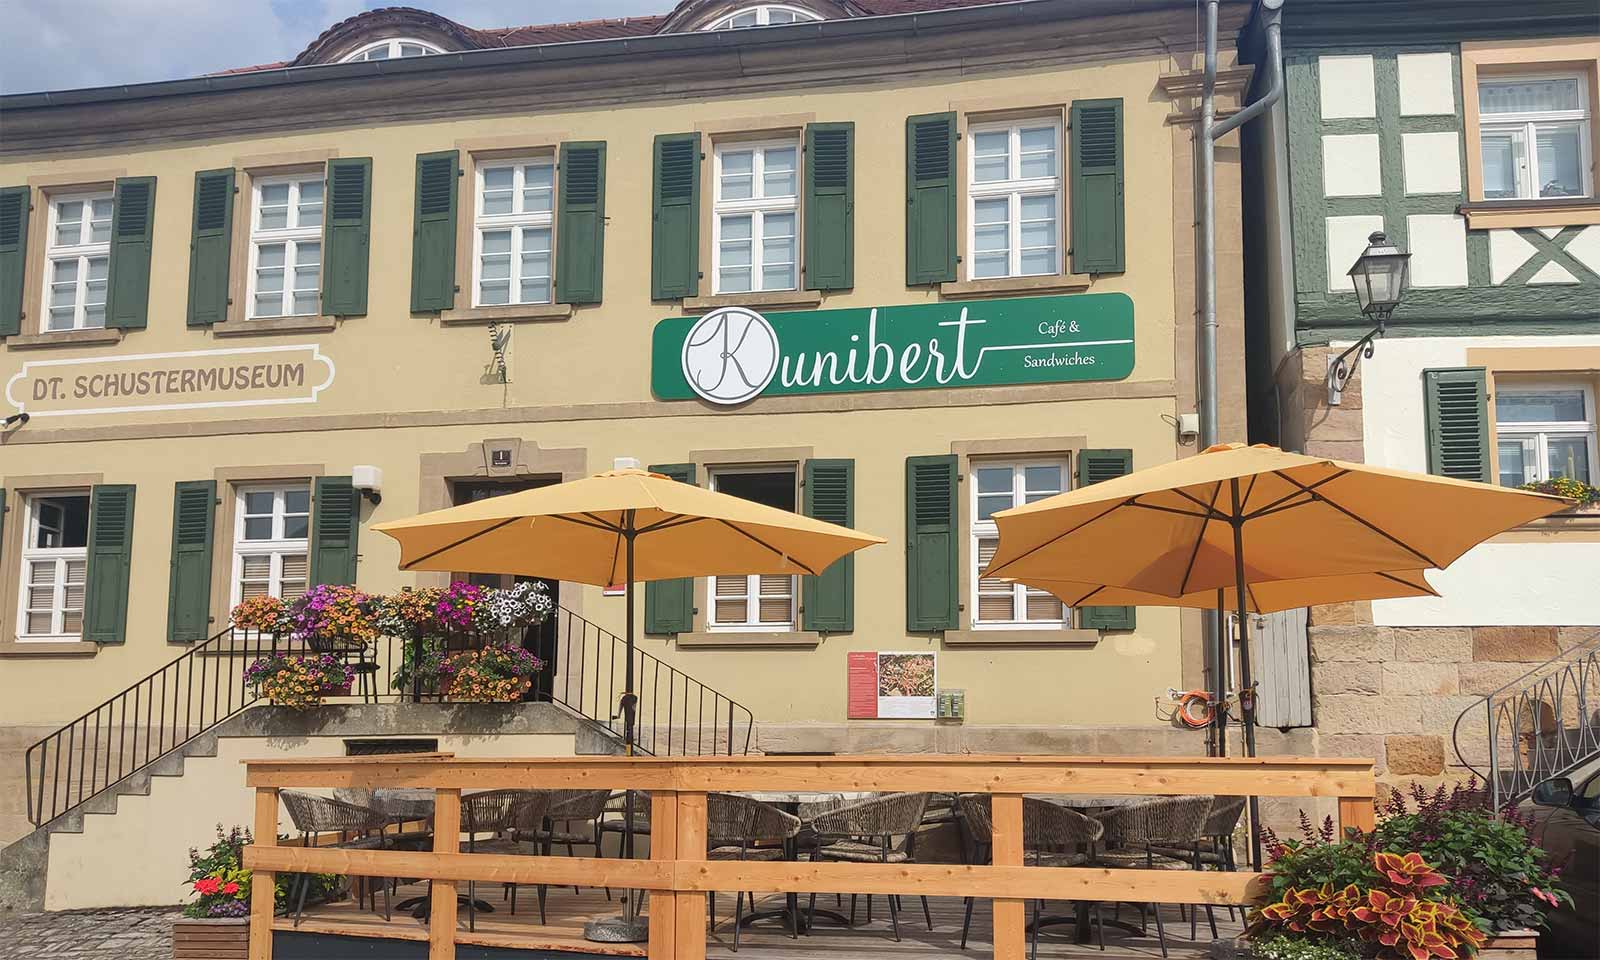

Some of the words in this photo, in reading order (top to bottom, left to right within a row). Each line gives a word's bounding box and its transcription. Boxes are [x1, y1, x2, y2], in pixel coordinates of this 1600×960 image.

[1038, 319, 1066, 338] Café
[1069, 320, 1080, 333] &
[688, 307, 986, 392] Kunibert
[1024, 351, 1096, 368] Sandwiches
[32, 377, 66, 401] DT.
[74, 363, 305, 399] SCHUSTERMUSEUM
